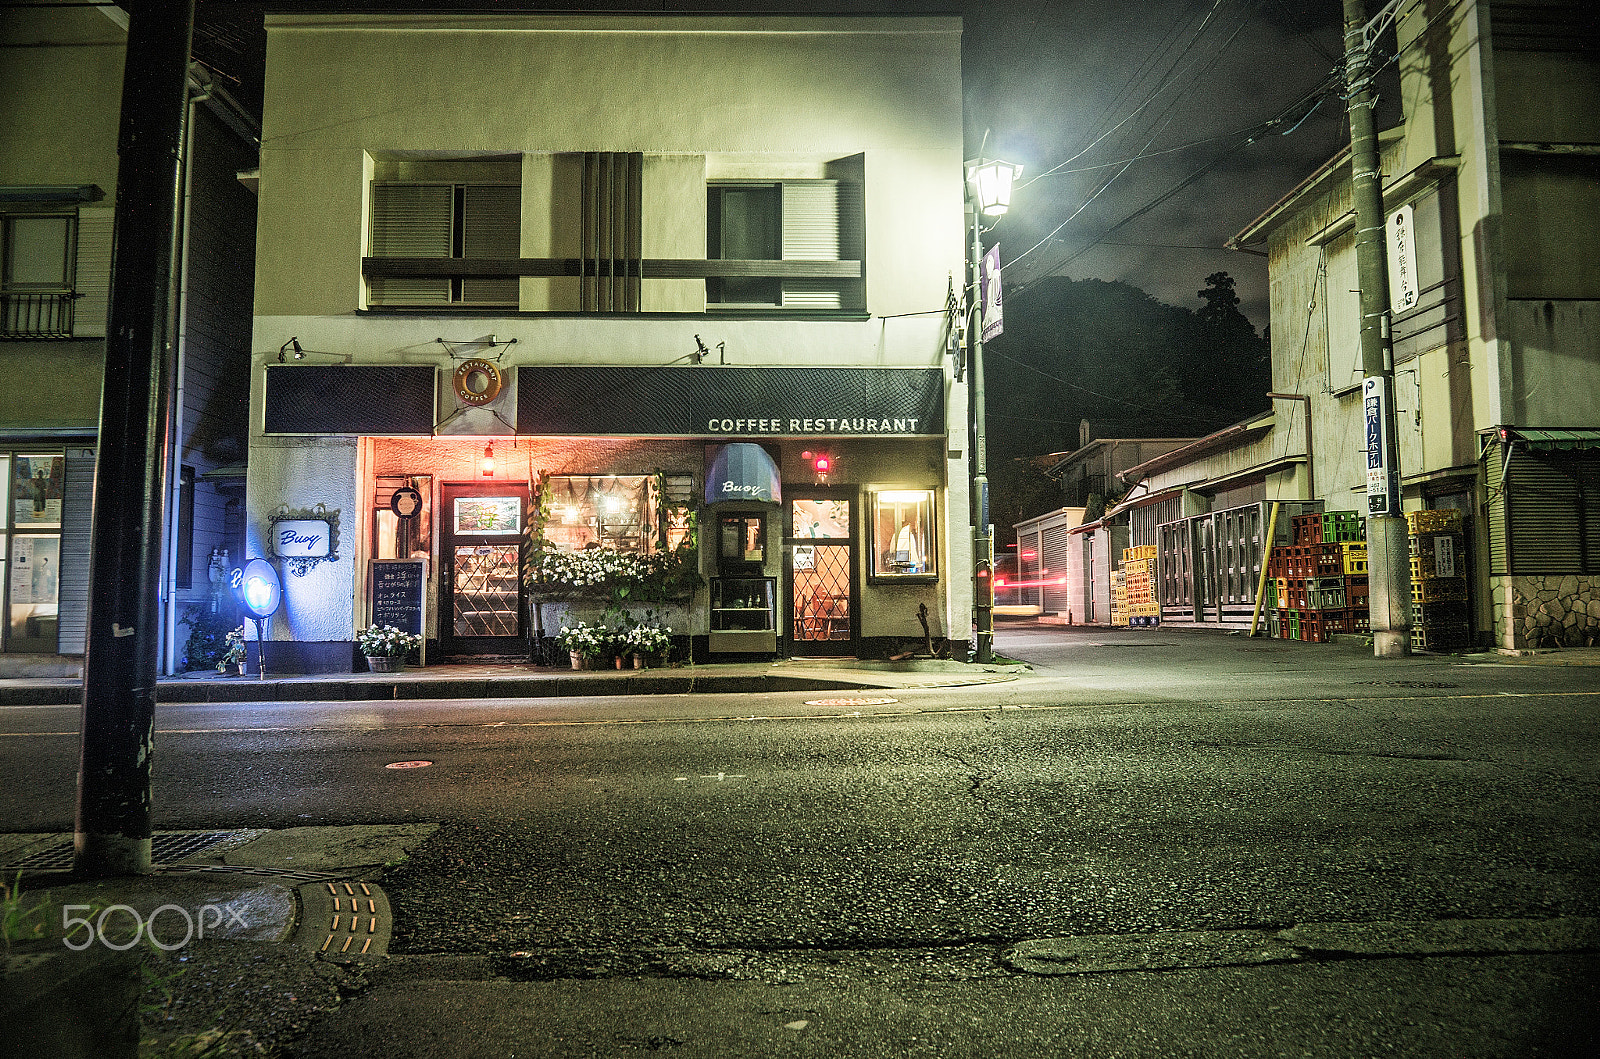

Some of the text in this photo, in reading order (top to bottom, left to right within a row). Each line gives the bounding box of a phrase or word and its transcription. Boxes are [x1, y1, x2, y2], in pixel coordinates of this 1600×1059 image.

[458, 362, 497, 381] RESTAURANT
[460, 390, 488, 401] COFFEE
[708, 417, 919, 432] COFFEE RESTAURANT
[1366, 397, 1380, 468] 鎌倉パークホテル
[722, 480, 768, 496] Buoy
[280, 529, 322, 550] Buoy
